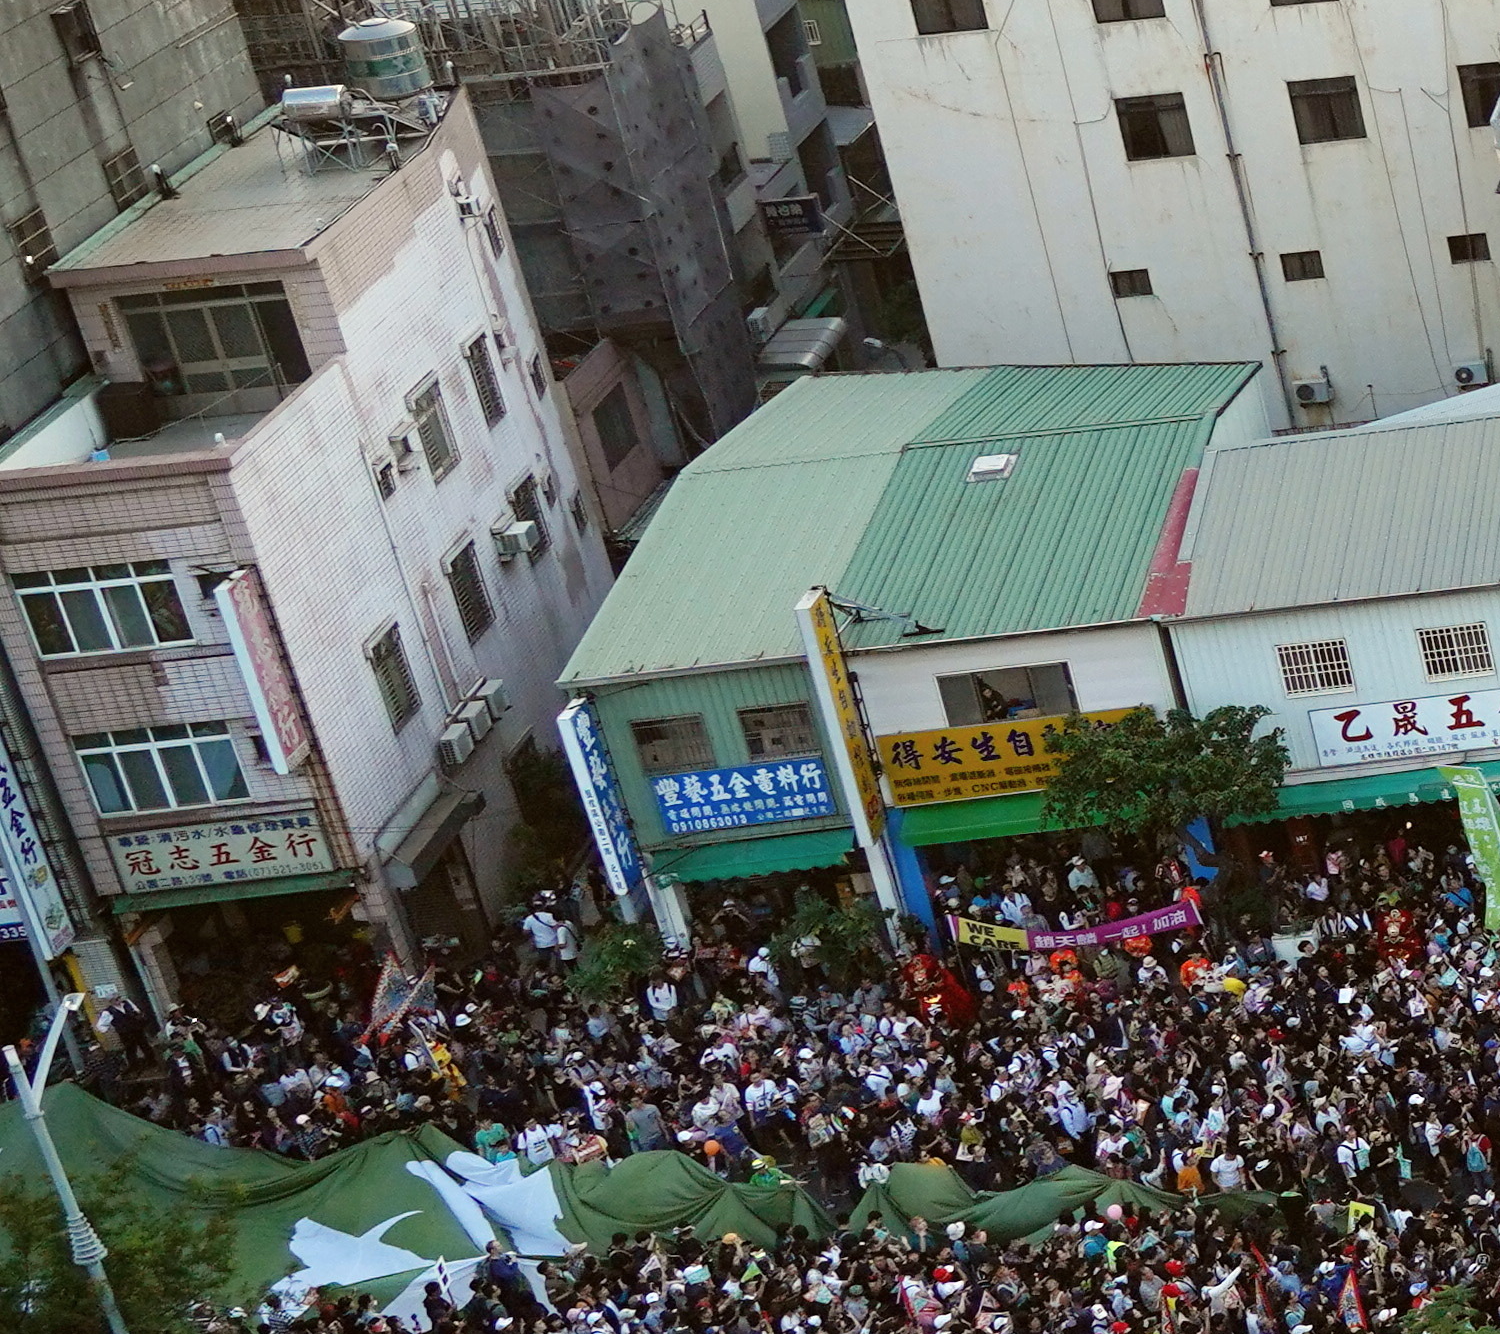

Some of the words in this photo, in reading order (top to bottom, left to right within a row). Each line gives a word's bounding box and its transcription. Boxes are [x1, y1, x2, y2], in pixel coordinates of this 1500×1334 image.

[655, 762, 823, 807] 豐藝五金電料行
[671, 814, 748, 833] 0910863013
[124, 832, 317, 877] 冠志五金行
[966, 920, 996, 939] WE
[1153, 909, 1188, 933] 加油
[969, 934, 1021, 951] CARE
